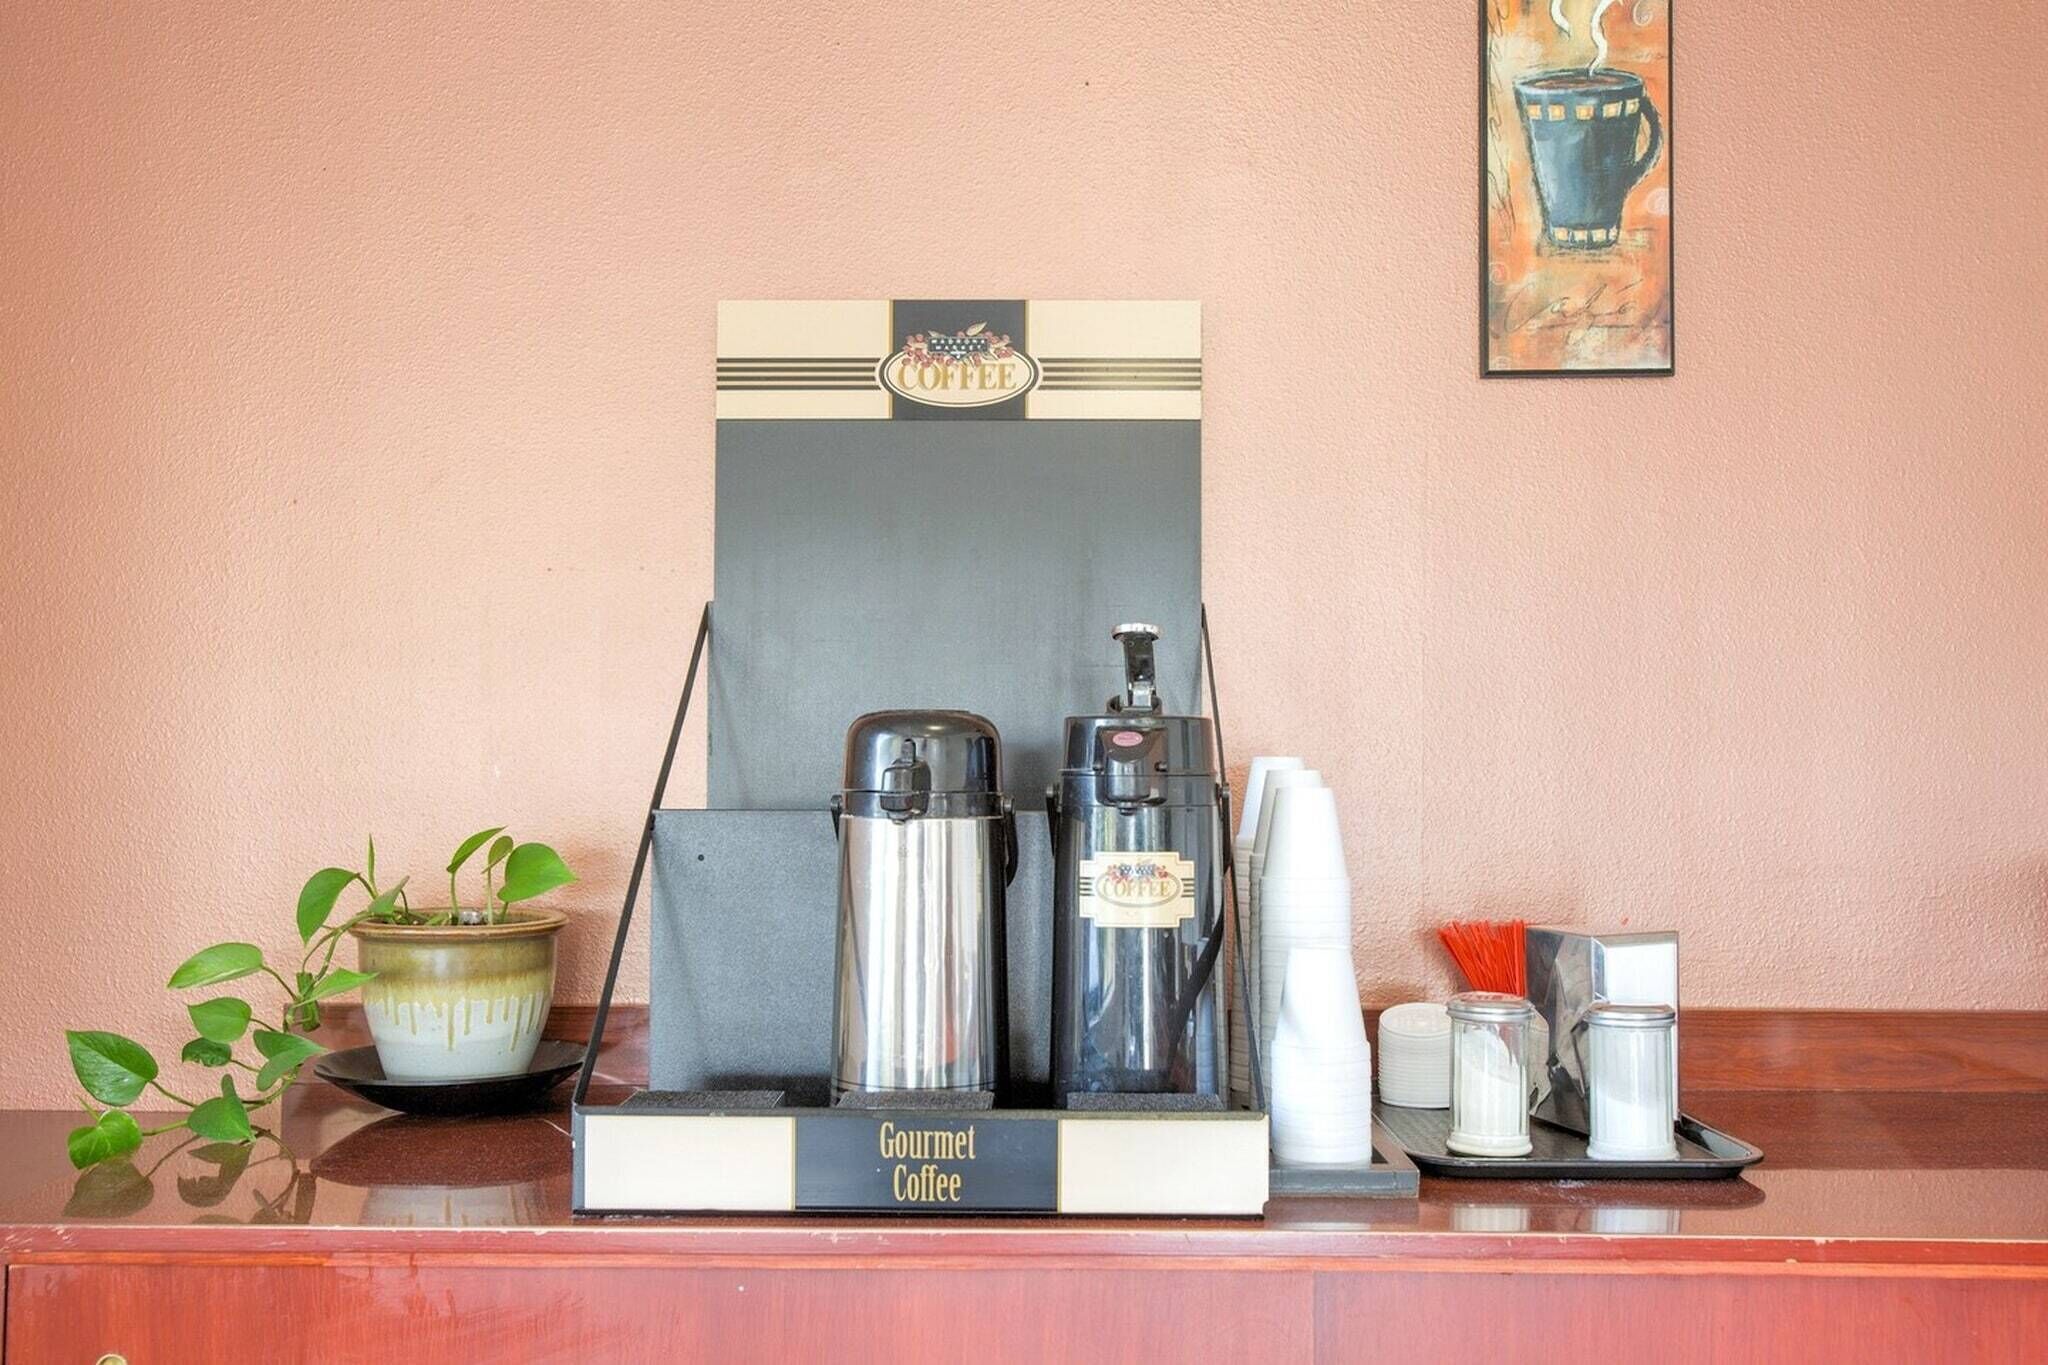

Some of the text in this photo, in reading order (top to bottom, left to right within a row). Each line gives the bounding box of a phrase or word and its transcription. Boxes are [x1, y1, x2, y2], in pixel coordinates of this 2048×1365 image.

[897, 362, 1017, 391] COFFEE
[1103, 879, 1170, 897] COFFEE
[879, 1120, 977, 1160] Gourmet
[893, 1163, 962, 1202] Coffee
